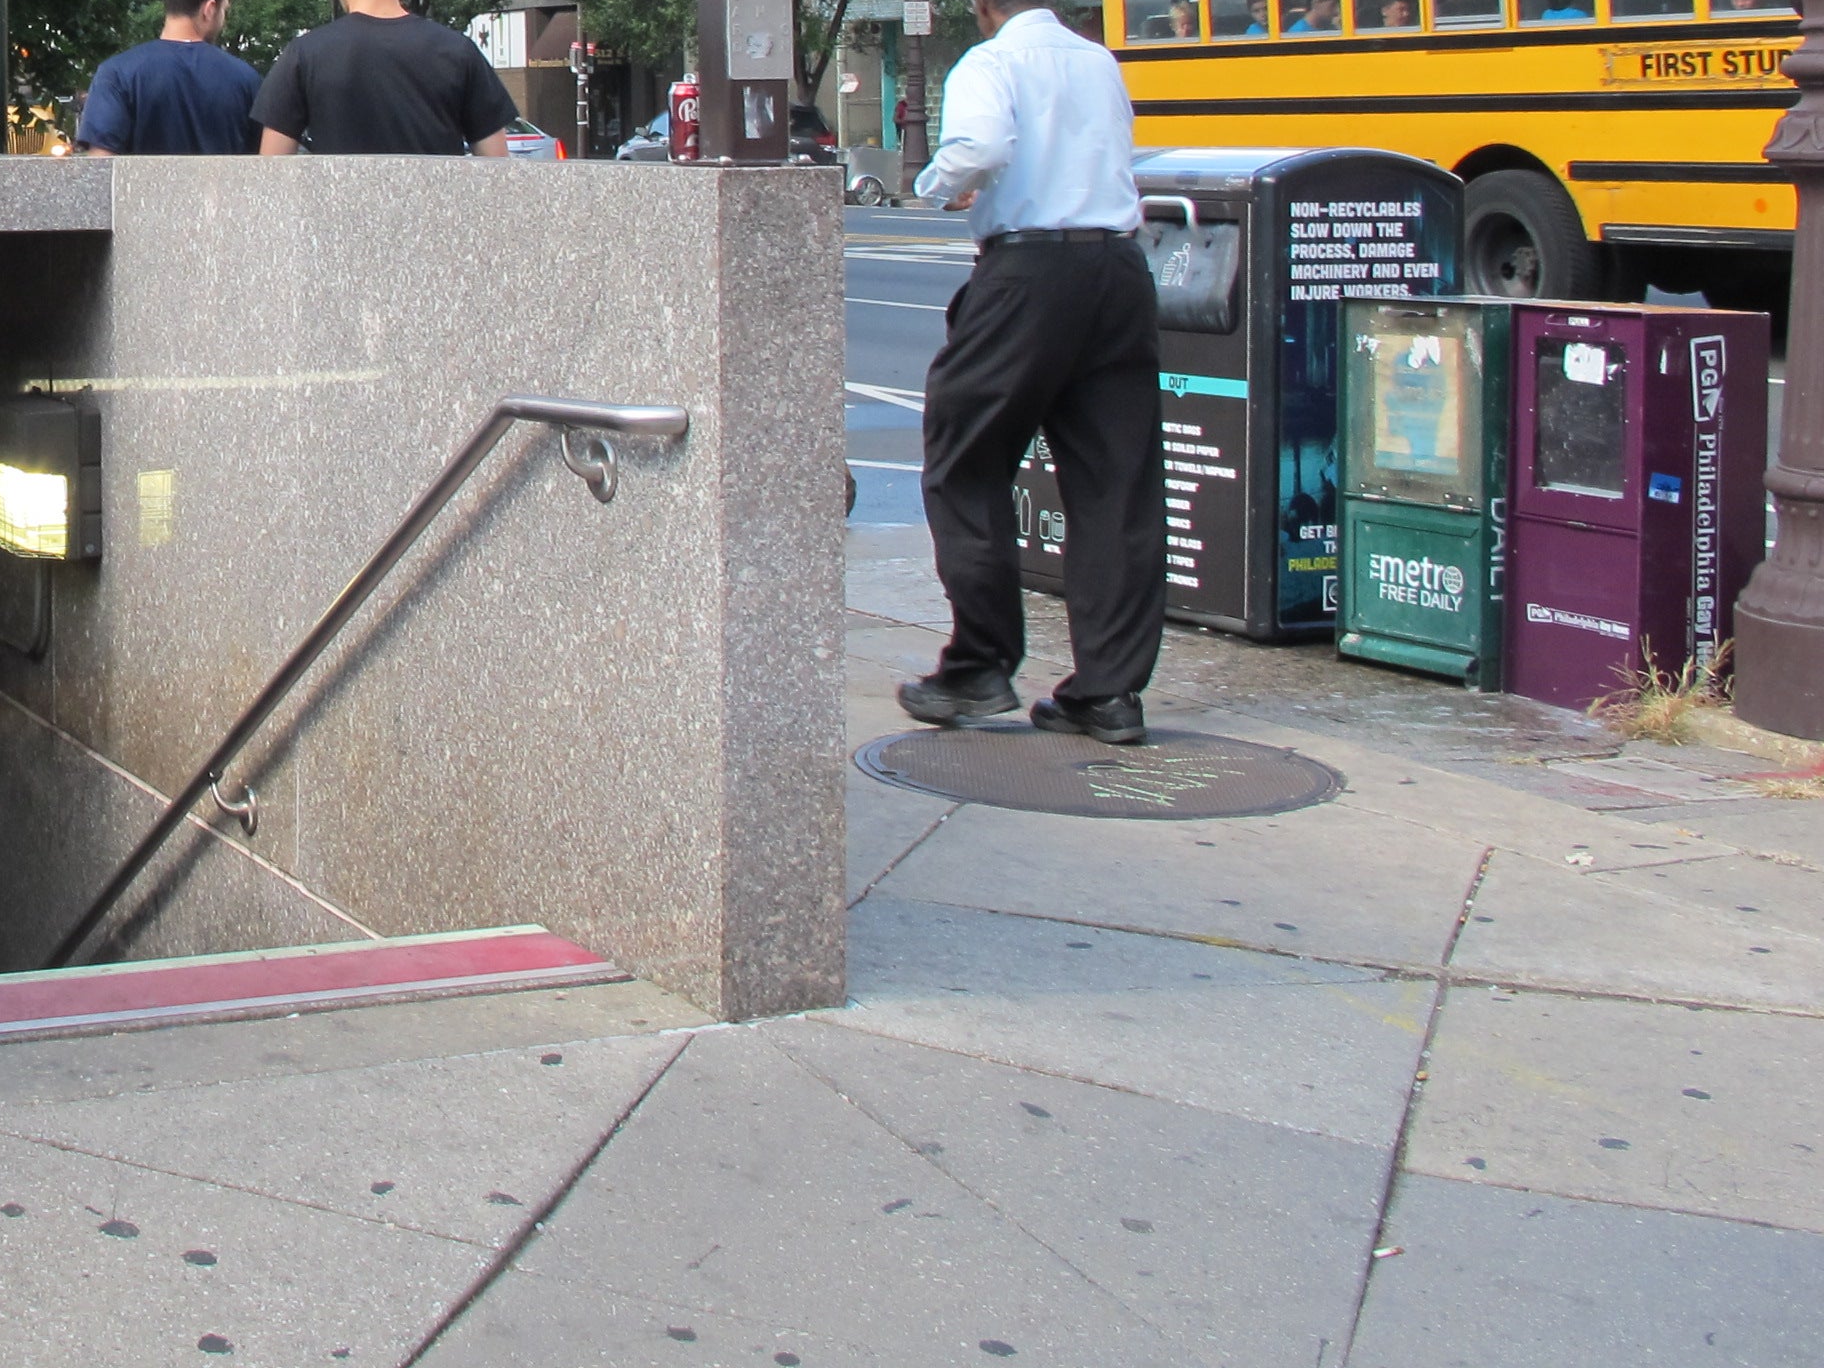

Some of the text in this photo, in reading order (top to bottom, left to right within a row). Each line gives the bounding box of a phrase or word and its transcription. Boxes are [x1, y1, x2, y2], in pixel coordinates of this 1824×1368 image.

[1640, 51, 1713, 78] FIRST
[1290, 202, 1422, 218] NON-RECYCLABLES
[1290, 222, 1404, 238] SLOW DOWN THE
[1290, 243, 1416, 260] PROCESS, DAMAGE
[1290, 263, 1439, 280] MACHINERY AND EVEN
[1290, 284, 1412, 301] INJURE WORKERS.
[1168, 375, 1189, 390] OUT
[1695, 433, 1717, 592] Philadelphia
[1299, 525, 1323, 539] GET
[1379, 582, 1463, 612] FREE DAILY
[1695, 595, 1715, 635] Gay
